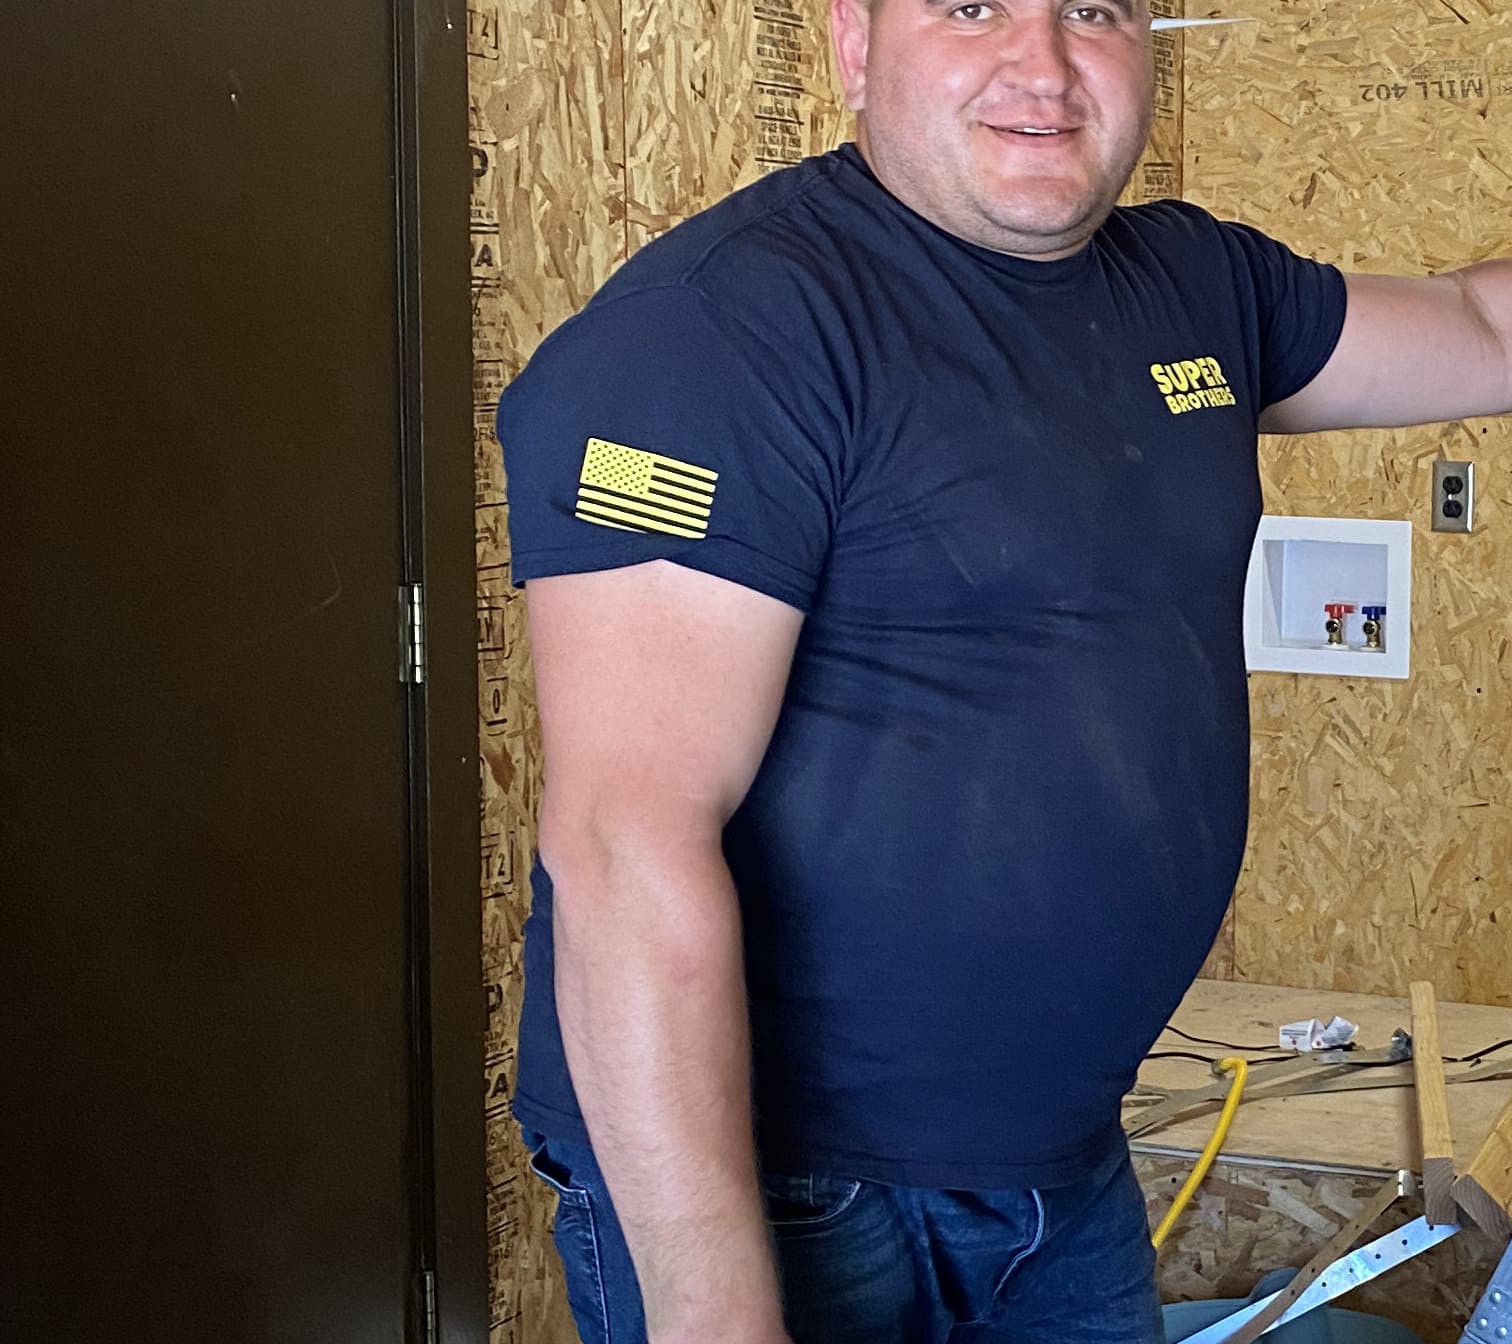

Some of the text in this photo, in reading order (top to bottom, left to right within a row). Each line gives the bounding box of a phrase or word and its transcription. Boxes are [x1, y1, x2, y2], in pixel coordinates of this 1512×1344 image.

[1359, 78, 1482, 102] MILL 402
[1149, 357, 1225, 396] SUPER
[1165, 386, 1236, 415] BROTHERS
